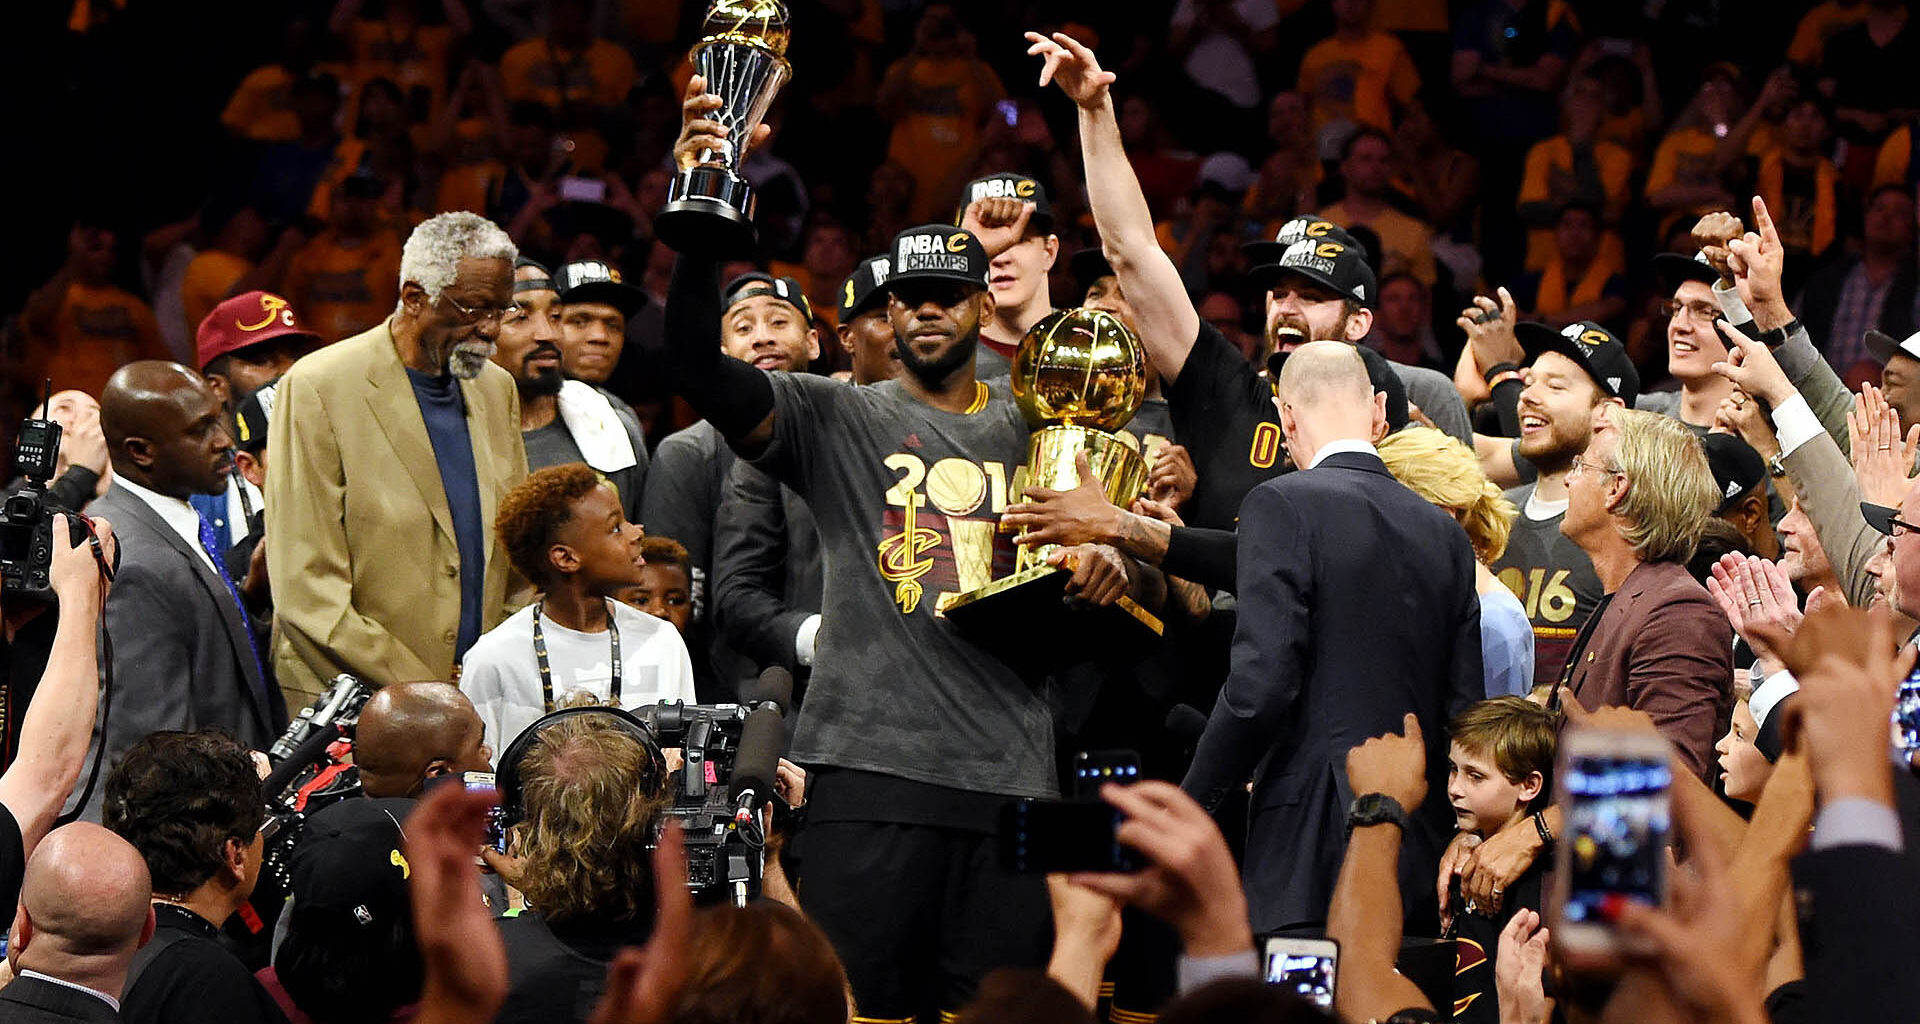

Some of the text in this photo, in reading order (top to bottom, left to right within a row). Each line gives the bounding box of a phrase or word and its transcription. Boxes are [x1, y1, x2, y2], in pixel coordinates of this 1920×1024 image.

[982, 179, 1017, 198] NBA
[908, 234, 946, 254] NBA
[909, 254, 969, 273] CHAMPS
